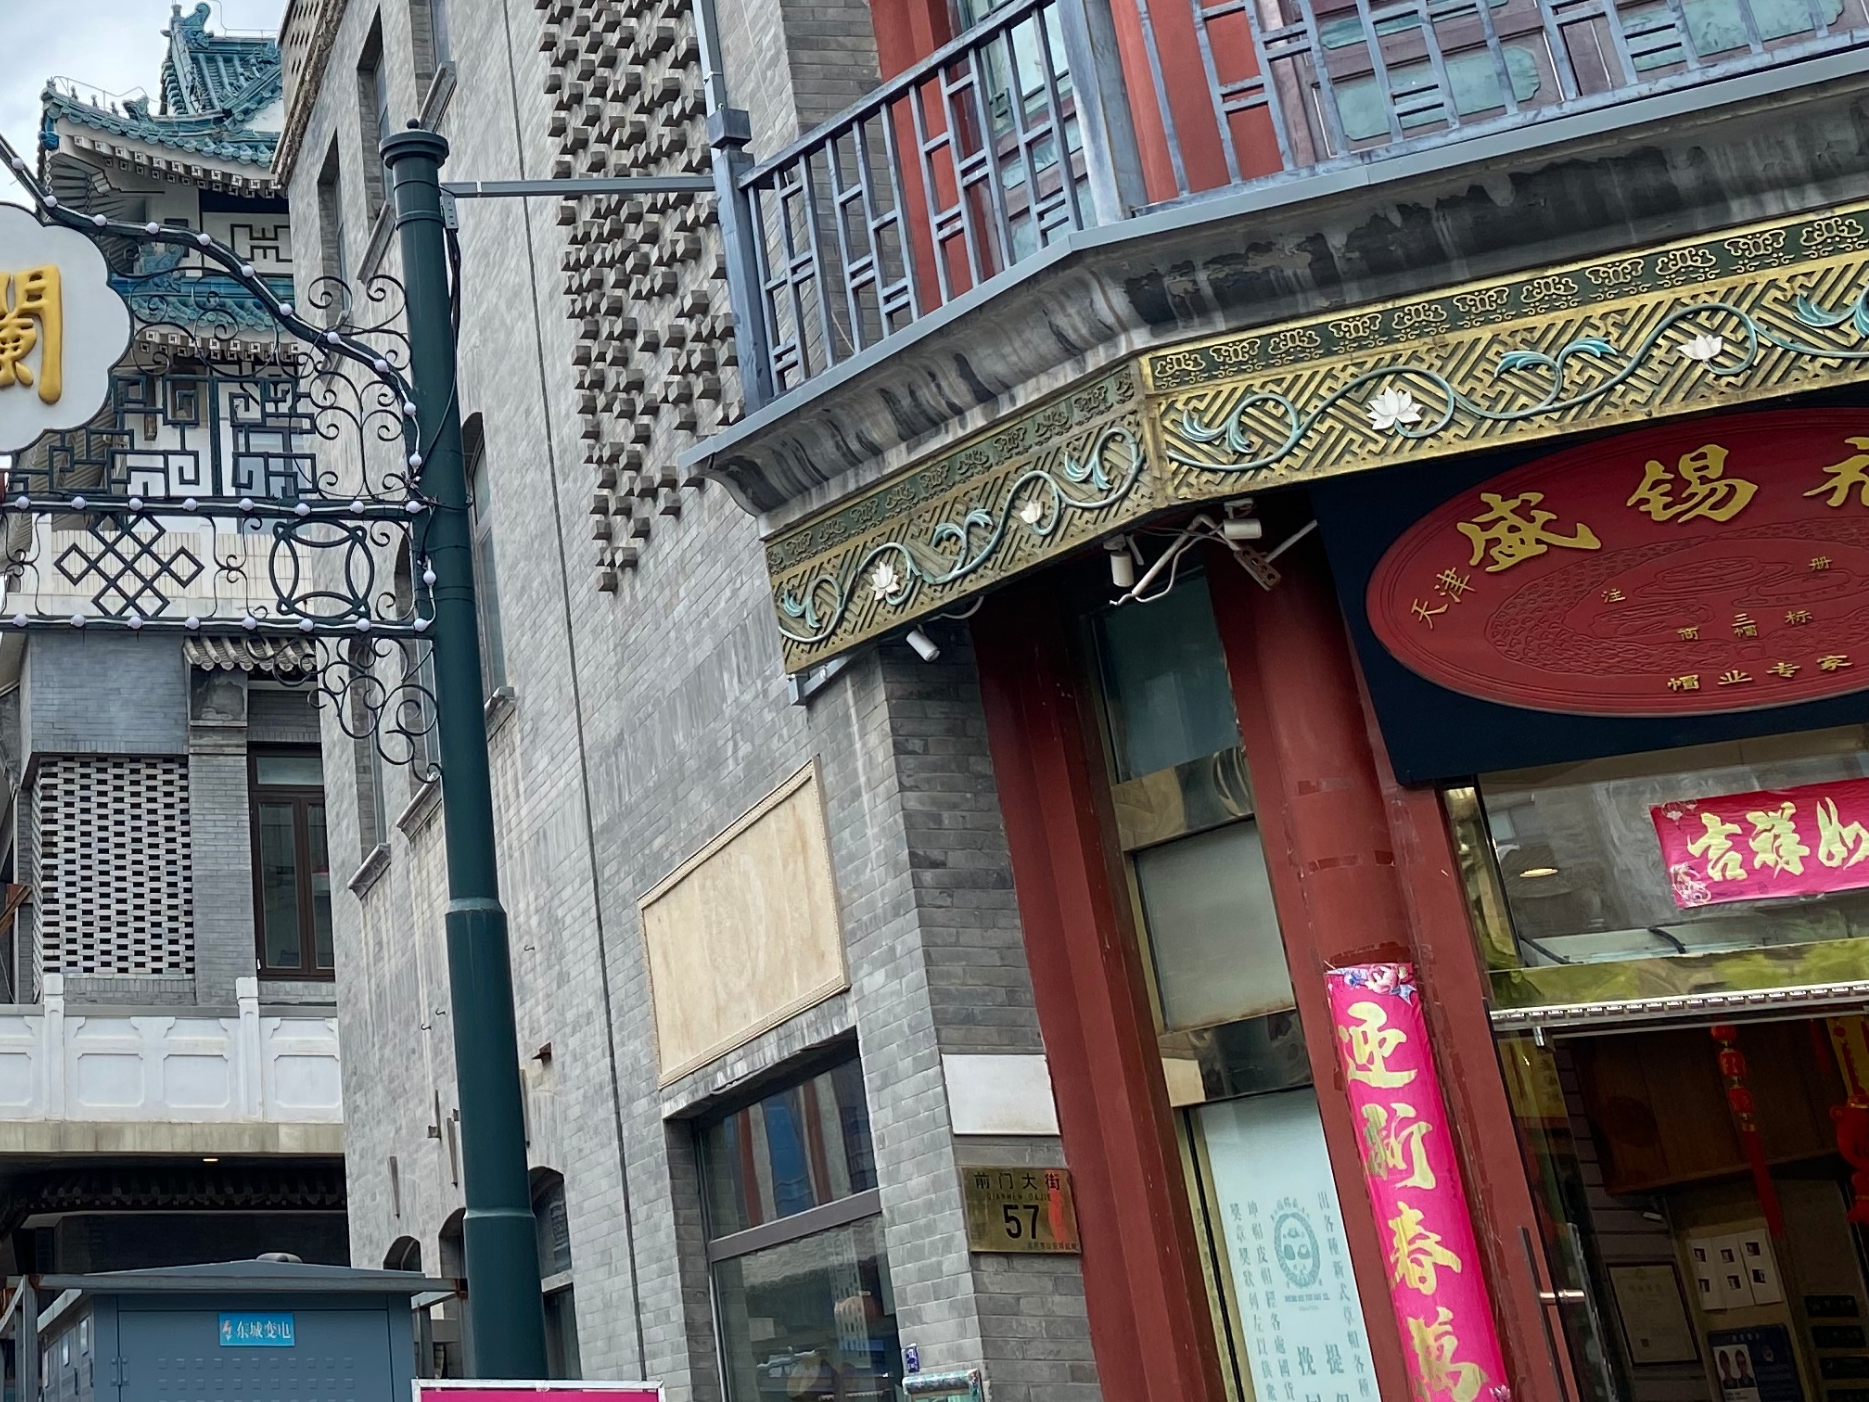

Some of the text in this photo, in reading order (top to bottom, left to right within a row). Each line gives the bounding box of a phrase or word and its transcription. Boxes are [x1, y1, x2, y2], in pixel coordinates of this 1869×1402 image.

[1410, 566, 1476, 630] 天津
[1667, 654, 1854, 691] 帽业专家
[1686, 796, 1869, 882] 吉祥如
[974, 1171, 1061, 1191] 前门大街
[1002, 1204, 1040, 1239] 57
